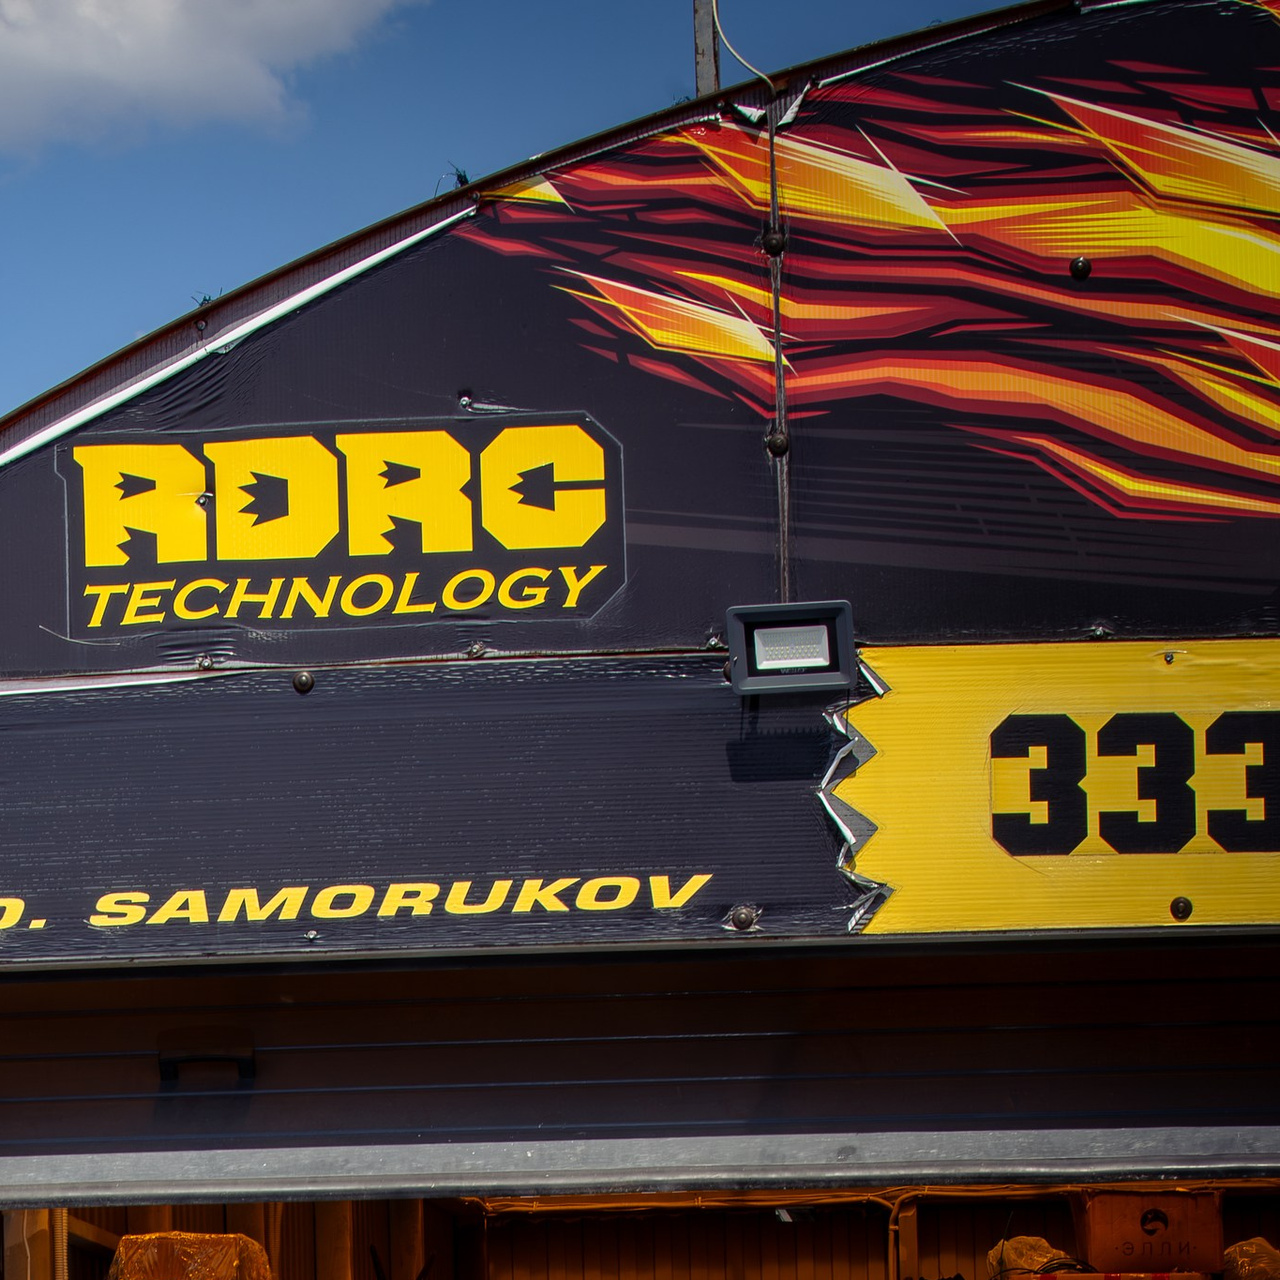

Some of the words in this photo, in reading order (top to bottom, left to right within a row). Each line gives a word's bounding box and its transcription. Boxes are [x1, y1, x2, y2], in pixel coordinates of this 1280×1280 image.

[73, 424, 608, 568] RDRC
[83, 564, 608, 628] TECHNOLOGY
[989, 710, 1280, 857] 333
[88, 873, 714, 927] SAMORUKOV
